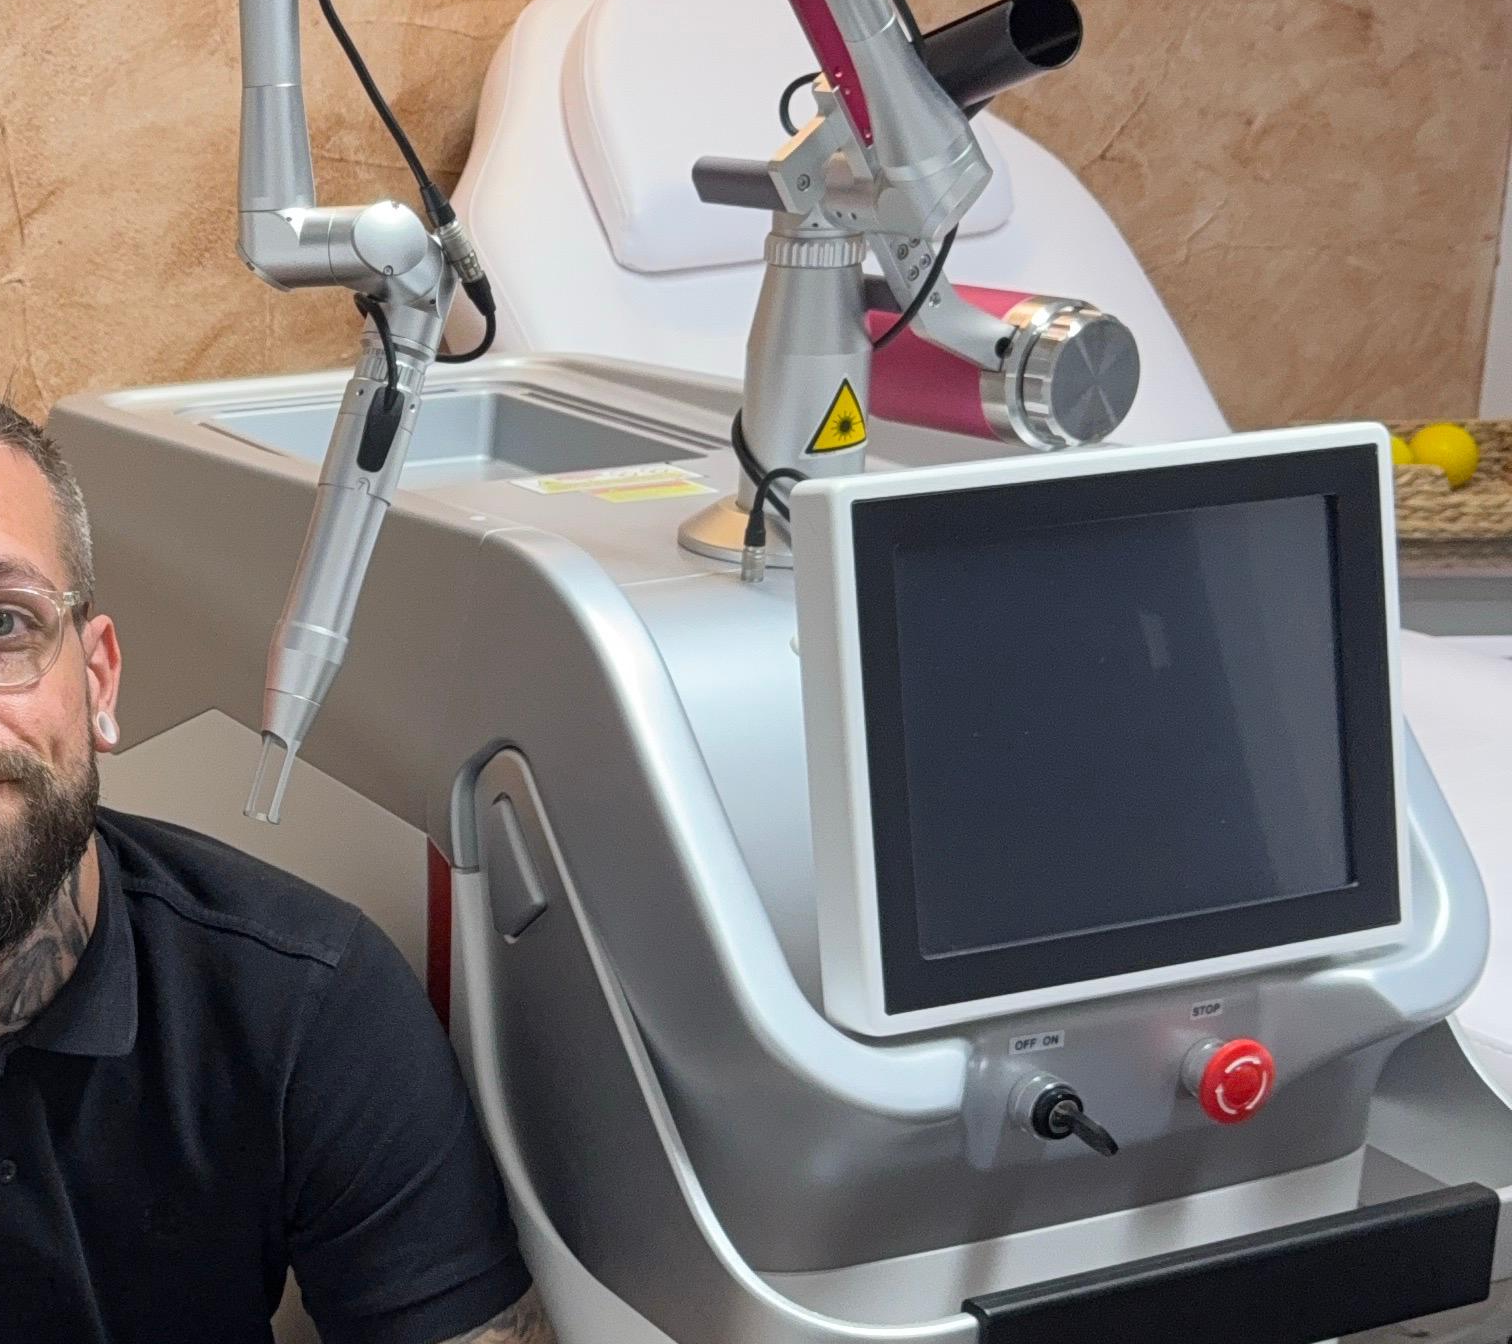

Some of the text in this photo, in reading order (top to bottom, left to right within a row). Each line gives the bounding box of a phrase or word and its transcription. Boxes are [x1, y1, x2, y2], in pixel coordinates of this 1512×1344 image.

[1192, 1004, 1221, 1017] STOP
[1015, 1034, 1059, 1051] OFF ON
